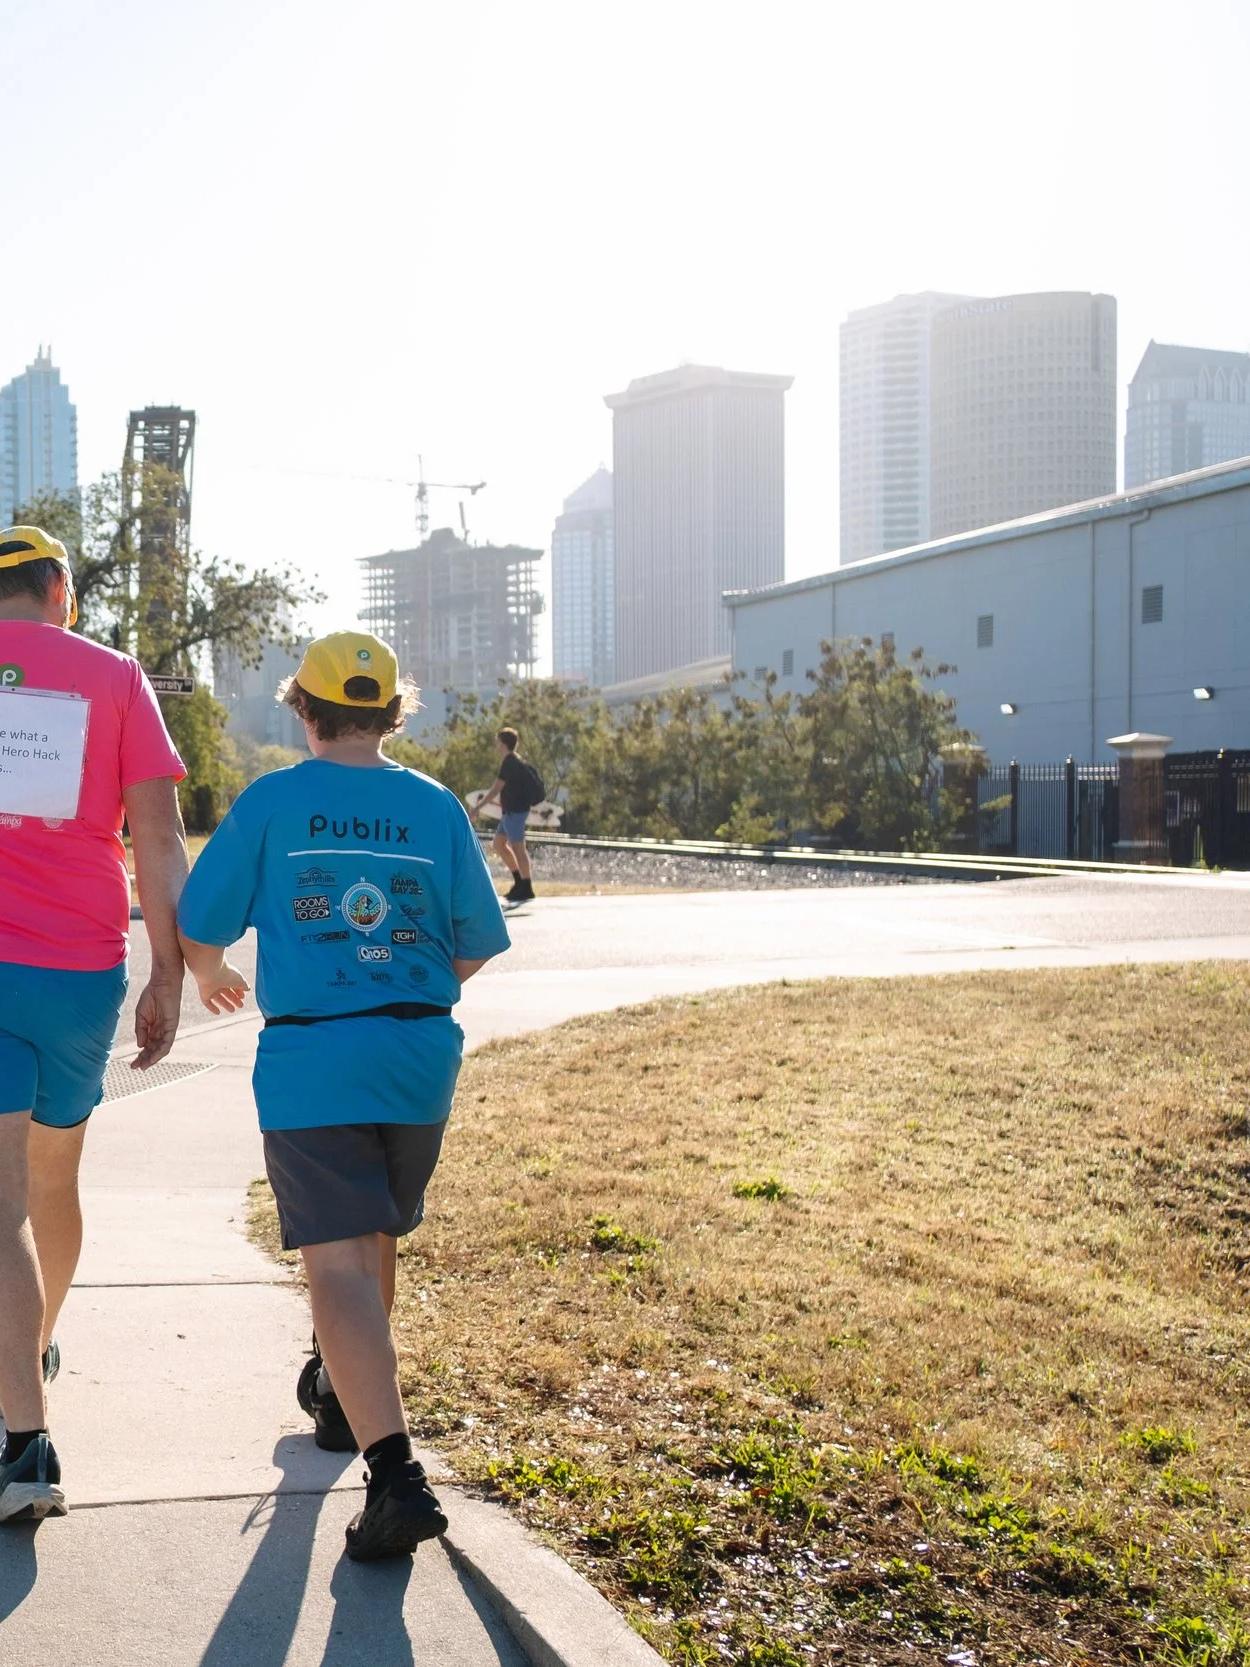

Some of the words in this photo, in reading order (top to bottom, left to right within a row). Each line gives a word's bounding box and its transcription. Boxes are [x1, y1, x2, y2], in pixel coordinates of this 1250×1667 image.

[2, 669, 17, 686] P
[152, 679, 183, 691] versity
[10, 730, 38, 742] what
[41, 734, 48, 743] a
[2, 746, 29, 758] Hero
[33, 748, 60, 761] Hack
[309, 814, 409, 843] Publix
[390, 877, 419, 887] TAMPA
[391, 885, 408, 894] BAY
[294, 897, 328, 909] ROOMS
[295, 911, 308, 920] TO
[309, 908, 325, 918] GO
[396, 932, 415, 940] TGH
[360, 946, 389, 960] Q105
